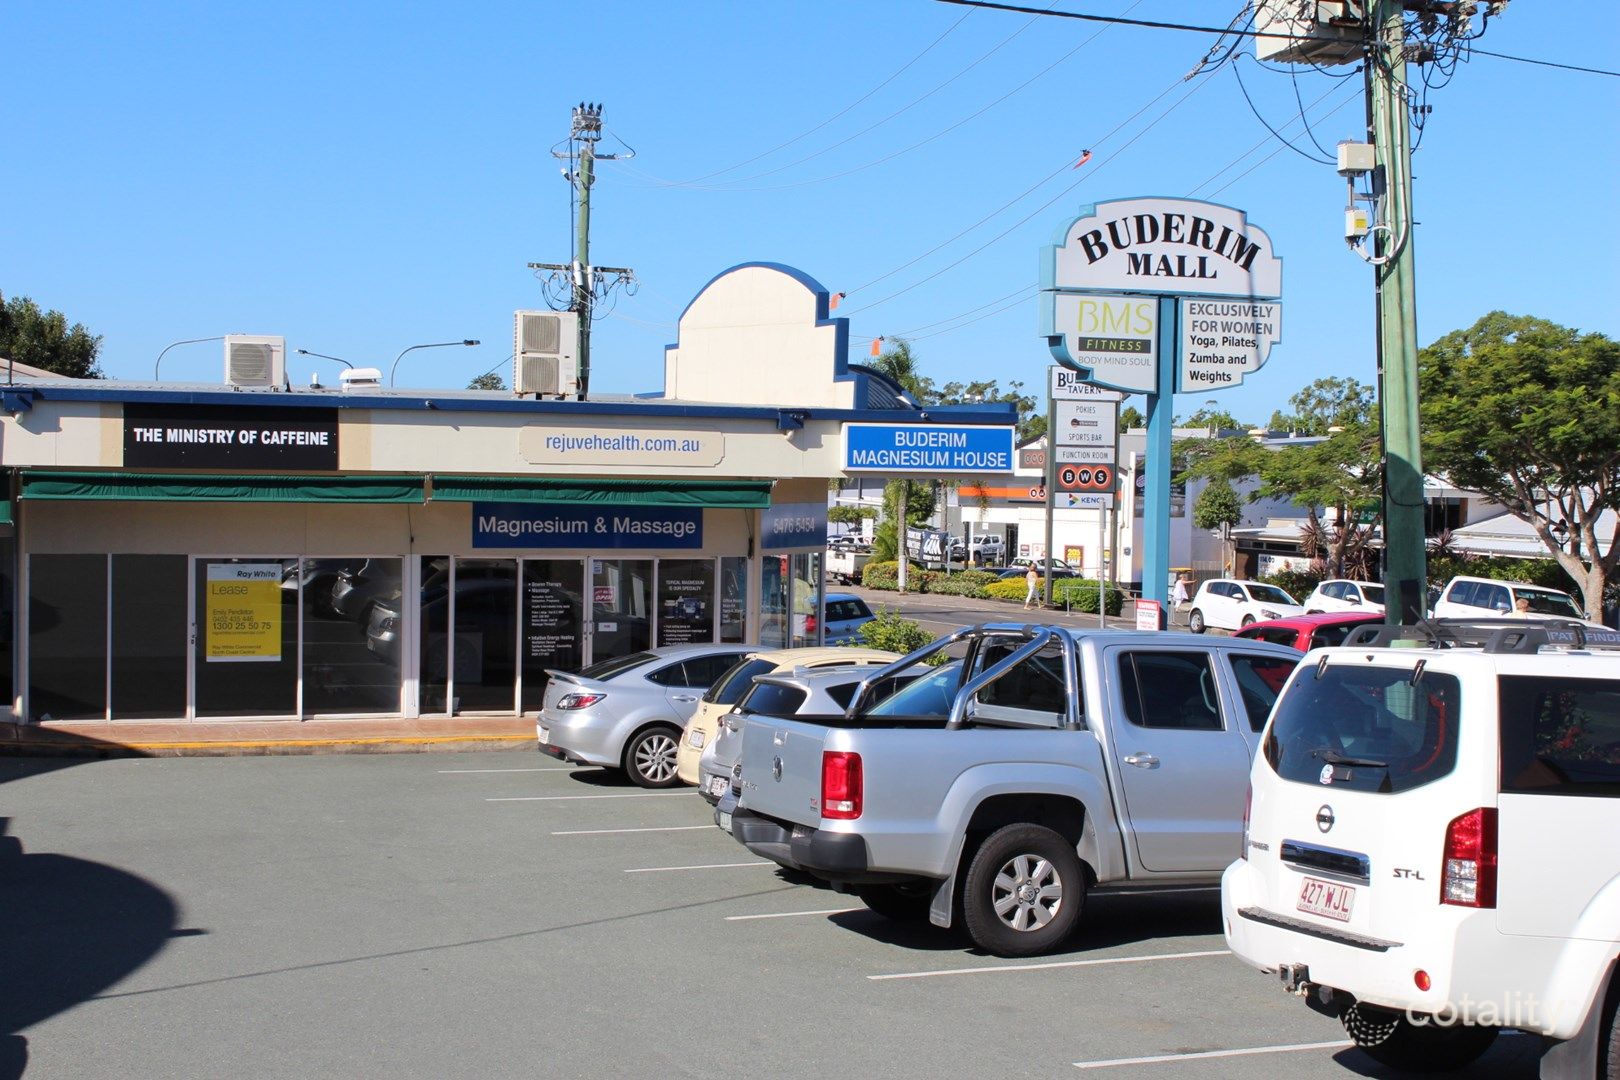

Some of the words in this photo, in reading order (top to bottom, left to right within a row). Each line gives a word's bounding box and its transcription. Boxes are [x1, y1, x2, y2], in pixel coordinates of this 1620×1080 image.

[1077, 213, 1261, 272] BUDERIM
[1126, 253, 1217, 279] MALL
[1077, 300, 1153, 335] BMS
[1189, 303, 1273, 318] EXCLUSIVELY
[1192, 320, 1218, 333] FOR
[1221, 321, 1273, 335] WOMEN
[1086, 339, 1142, 351] FITNESS
[1189, 335, 1218, 348] Yoga,
[1222, 337, 1260, 348] Pilates,
[1078, 356, 1102, 364] BODY
[1104, 357, 1127, 365] MIND
[1129, 358, 1152, 367] SOUL
[1189, 353, 1225, 364] Zumba
[1228, 354, 1247, 365] and
[1189, 371, 1232, 383] Weights
[1067, 386, 1102, 394] TAVERN
[134, 428, 162, 442] THE
[167, 429, 235, 444] MINISTRY
[239, 431, 257, 445] OF
[261, 431, 328, 446] CAFFEINE
[546, 434, 700, 453] rejuvehealth.com.au
[895, 431, 966, 447] BUDERIM
[853, 450, 949, 466] MAGNESIUM
[954, 452, 1007, 467] HOUSE
[1062, 451, 1091, 459] FUNCTION
[1092, 451, 1108, 459] ROOM
[479, 516, 588, 536] Magnesium
[595, 517, 607, 533] &
[613, 517, 696, 537] Massage
[773, 518, 794, 533] 5476
[796, 518, 815, 533] 5454
[212, 583, 248, 595] Lease
[213, 622, 233, 630] 1300
[235, 622, 245, 630] 25
[248, 622, 259, 630] 50
[261, 622, 271, 630] 75
[1393, 868, 1425, 881] ST-L
